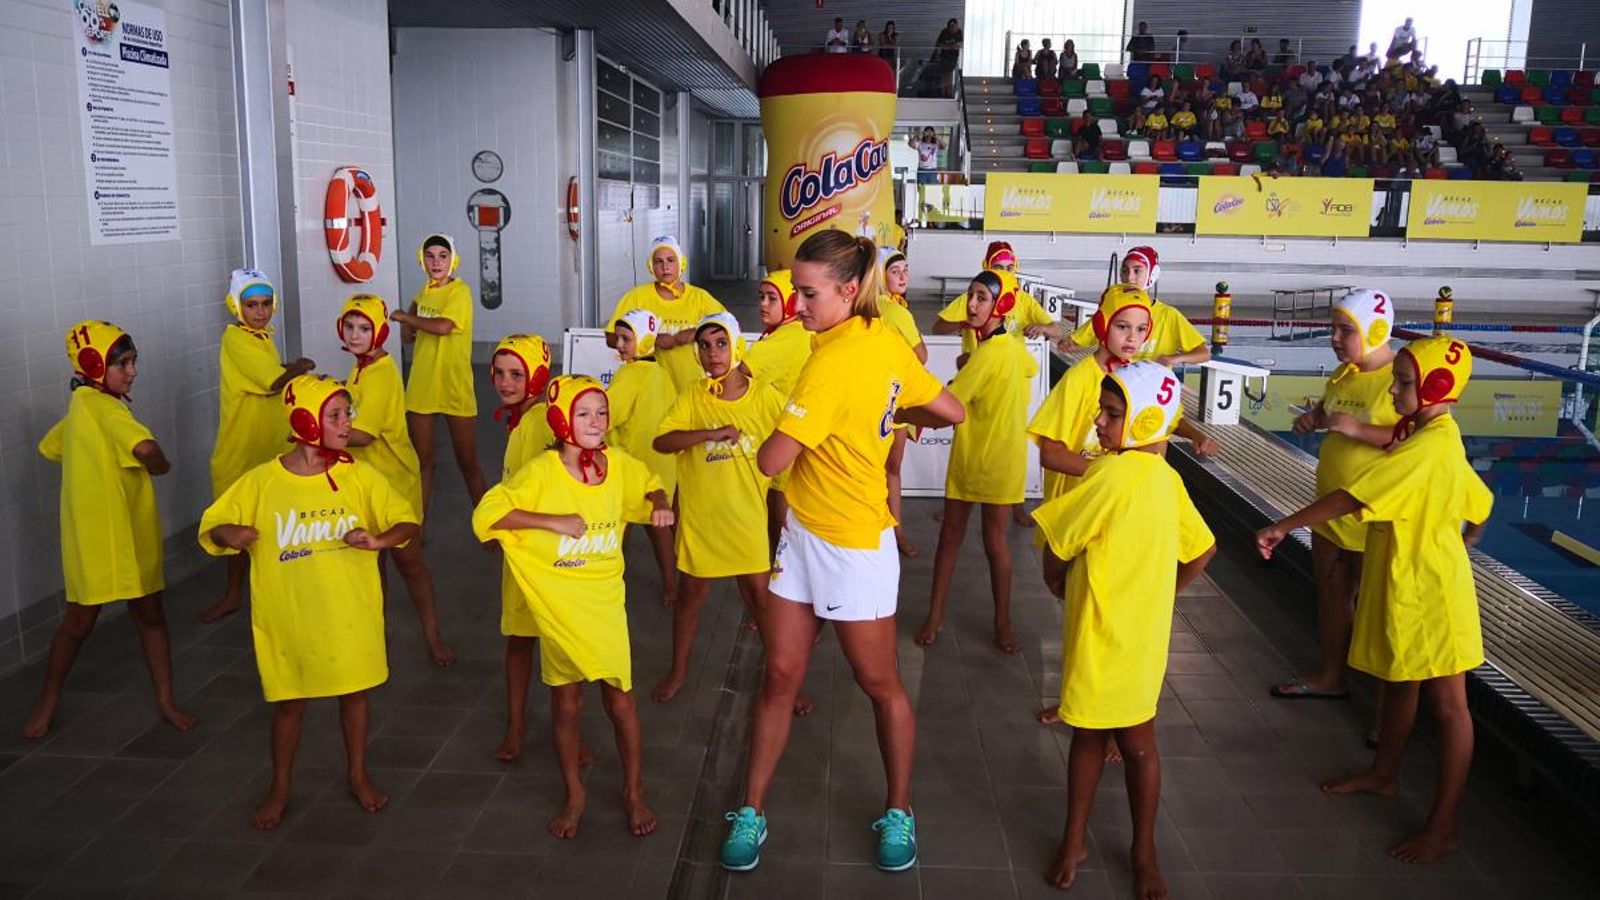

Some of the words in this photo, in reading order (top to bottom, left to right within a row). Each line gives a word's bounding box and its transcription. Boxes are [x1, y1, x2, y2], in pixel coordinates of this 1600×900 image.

[122, 22, 145, 38] NORMAS
[145, 26, 152, 40] DE
[152, 29, 163, 42] USO
[122, 45, 140, 60] Piscina
[780, 138, 889, 220] ColaCao
[792, 205, 840, 235] ORIGINAL
[1048, 296, 1057, 313] 8
[1373, 293, 1386, 314] 2
[648, 315, 656, 332] 6
[71, 325, 92, 350] 11
[1445, 341, 1464, 365] 5
[284, 382, 296, 406] 4
[1156, 376, 1175, 405] 5
[1217, 380, 1233, 410] 5
[300, 508, 345, 520] BECAS
